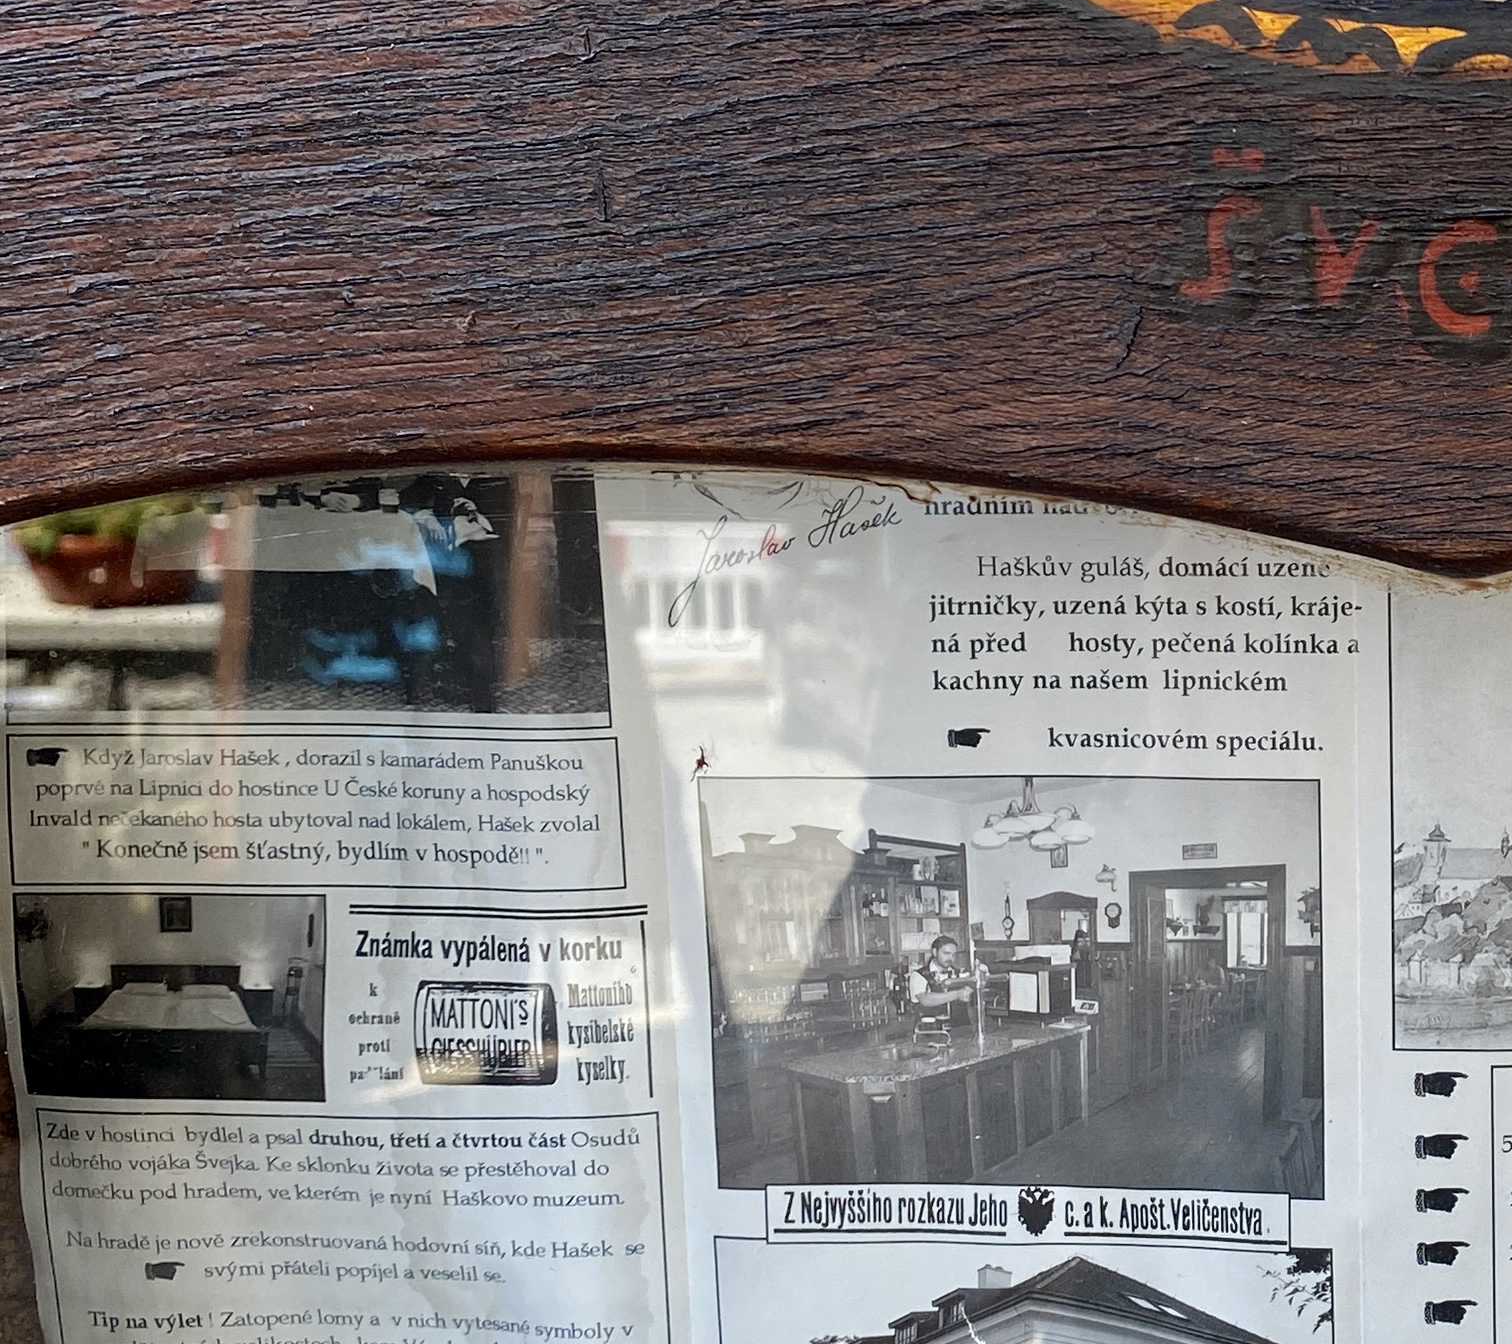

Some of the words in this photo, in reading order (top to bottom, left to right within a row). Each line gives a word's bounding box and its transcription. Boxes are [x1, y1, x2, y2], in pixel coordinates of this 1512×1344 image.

[932, 667, 1024, 697] kachny
[1032, 672, 1062, 691] na
[1069, 669, 1148, 691] našem
[1162, 668, 1288, 698] lipnickém
[1047, 726, 1209, 750] kvasnicovém
[1215, 727, 1325, 754] speciálu.
[355, 930, 433, 960] Známka
[440, 932, 531, 967] vypálená
[539, 940, 551, 961] v
[558, 936, 623, 963] korku
[784, 1192, 796, 1224] Z
[800, 1189, 893, 1231] Nejvyššího
[898, 1193, 964, 1227] rozkazu
[967, 1193, 1009, 1228] Jeho
[1064, 1202, 1079, 1227] c.
[1082, 1203, 1094, 1228] a
[1098, 1198, 1115, 1229] k.
